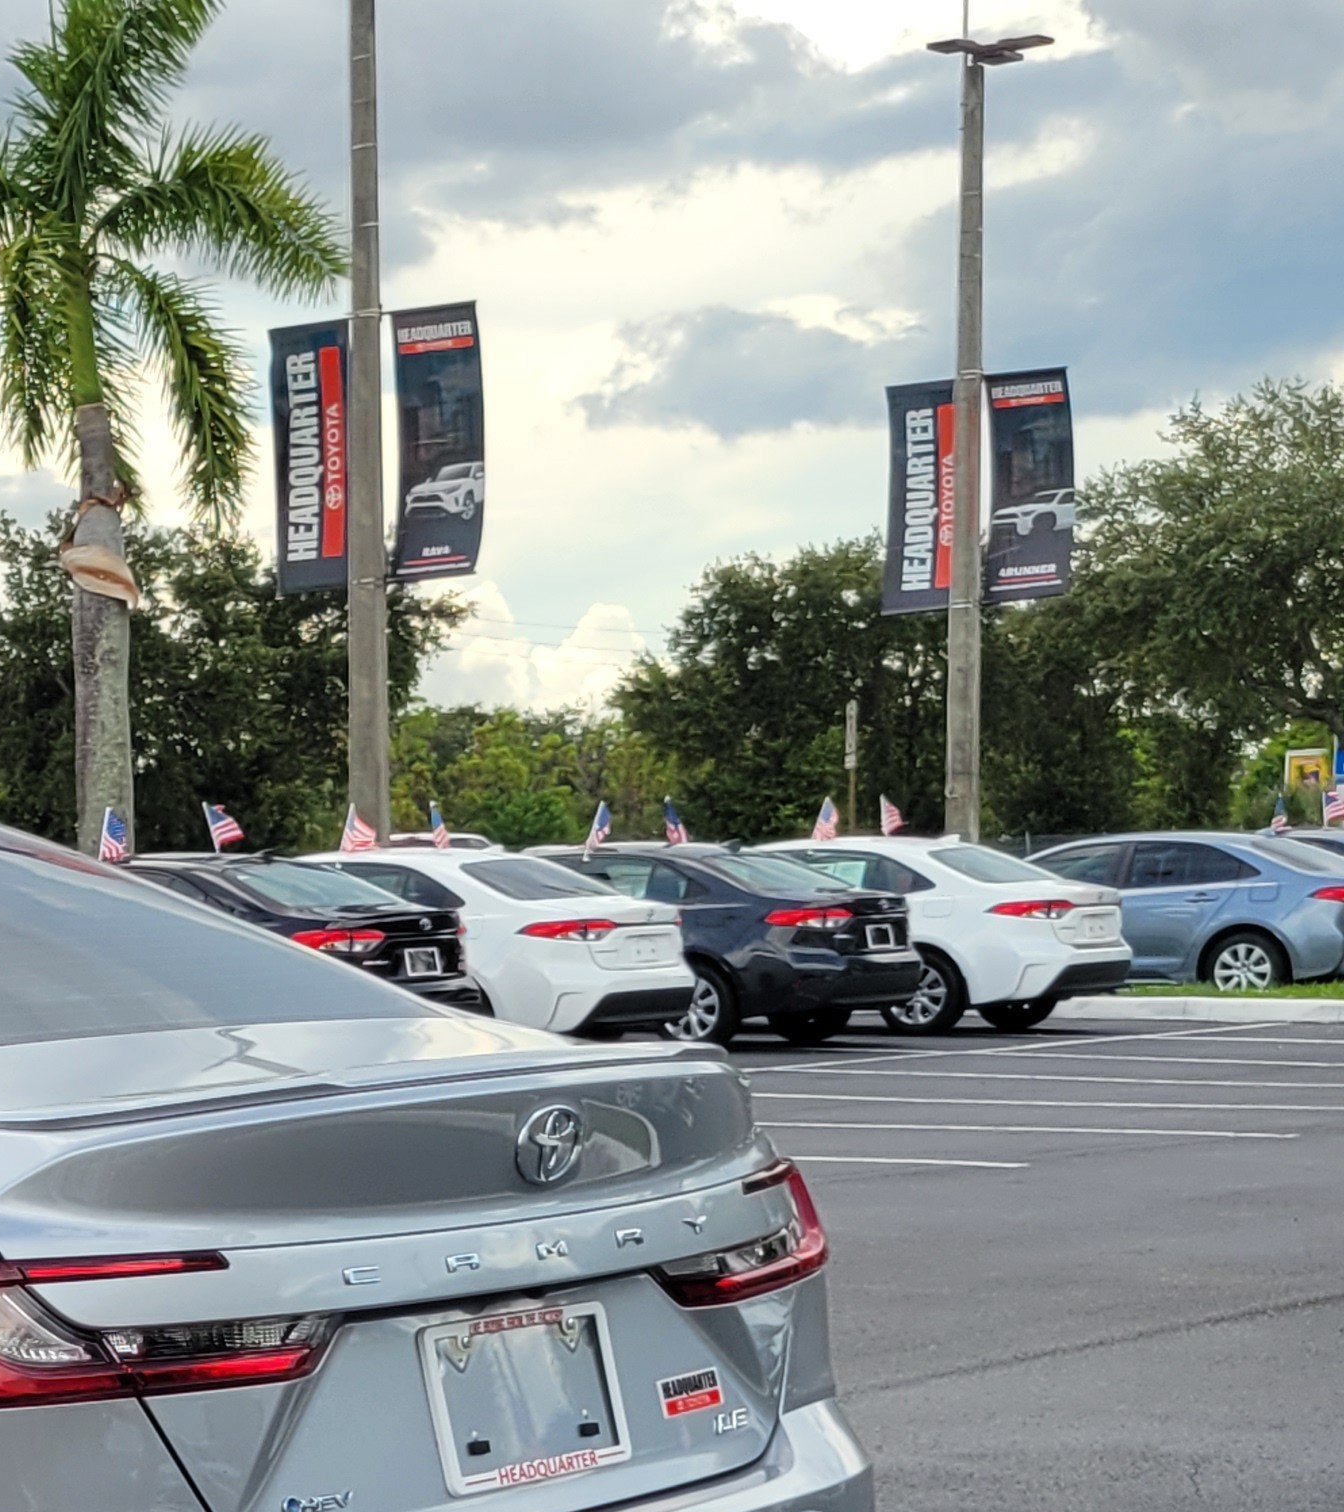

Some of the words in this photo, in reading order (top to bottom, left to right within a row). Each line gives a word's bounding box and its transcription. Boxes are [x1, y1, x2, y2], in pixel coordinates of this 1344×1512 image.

[286, 350, 324, 562] HEADQUARTER
[325, 403, 342, 483] TOYOTA
[901, 407, 939, 591] HEADQUARTER
[342, 1214, 707, 1285] CAMRY
[661, 1370, 718, 1399] HEADQUARTER
[498, 1450, 598, 1485] HEADQUARTER
